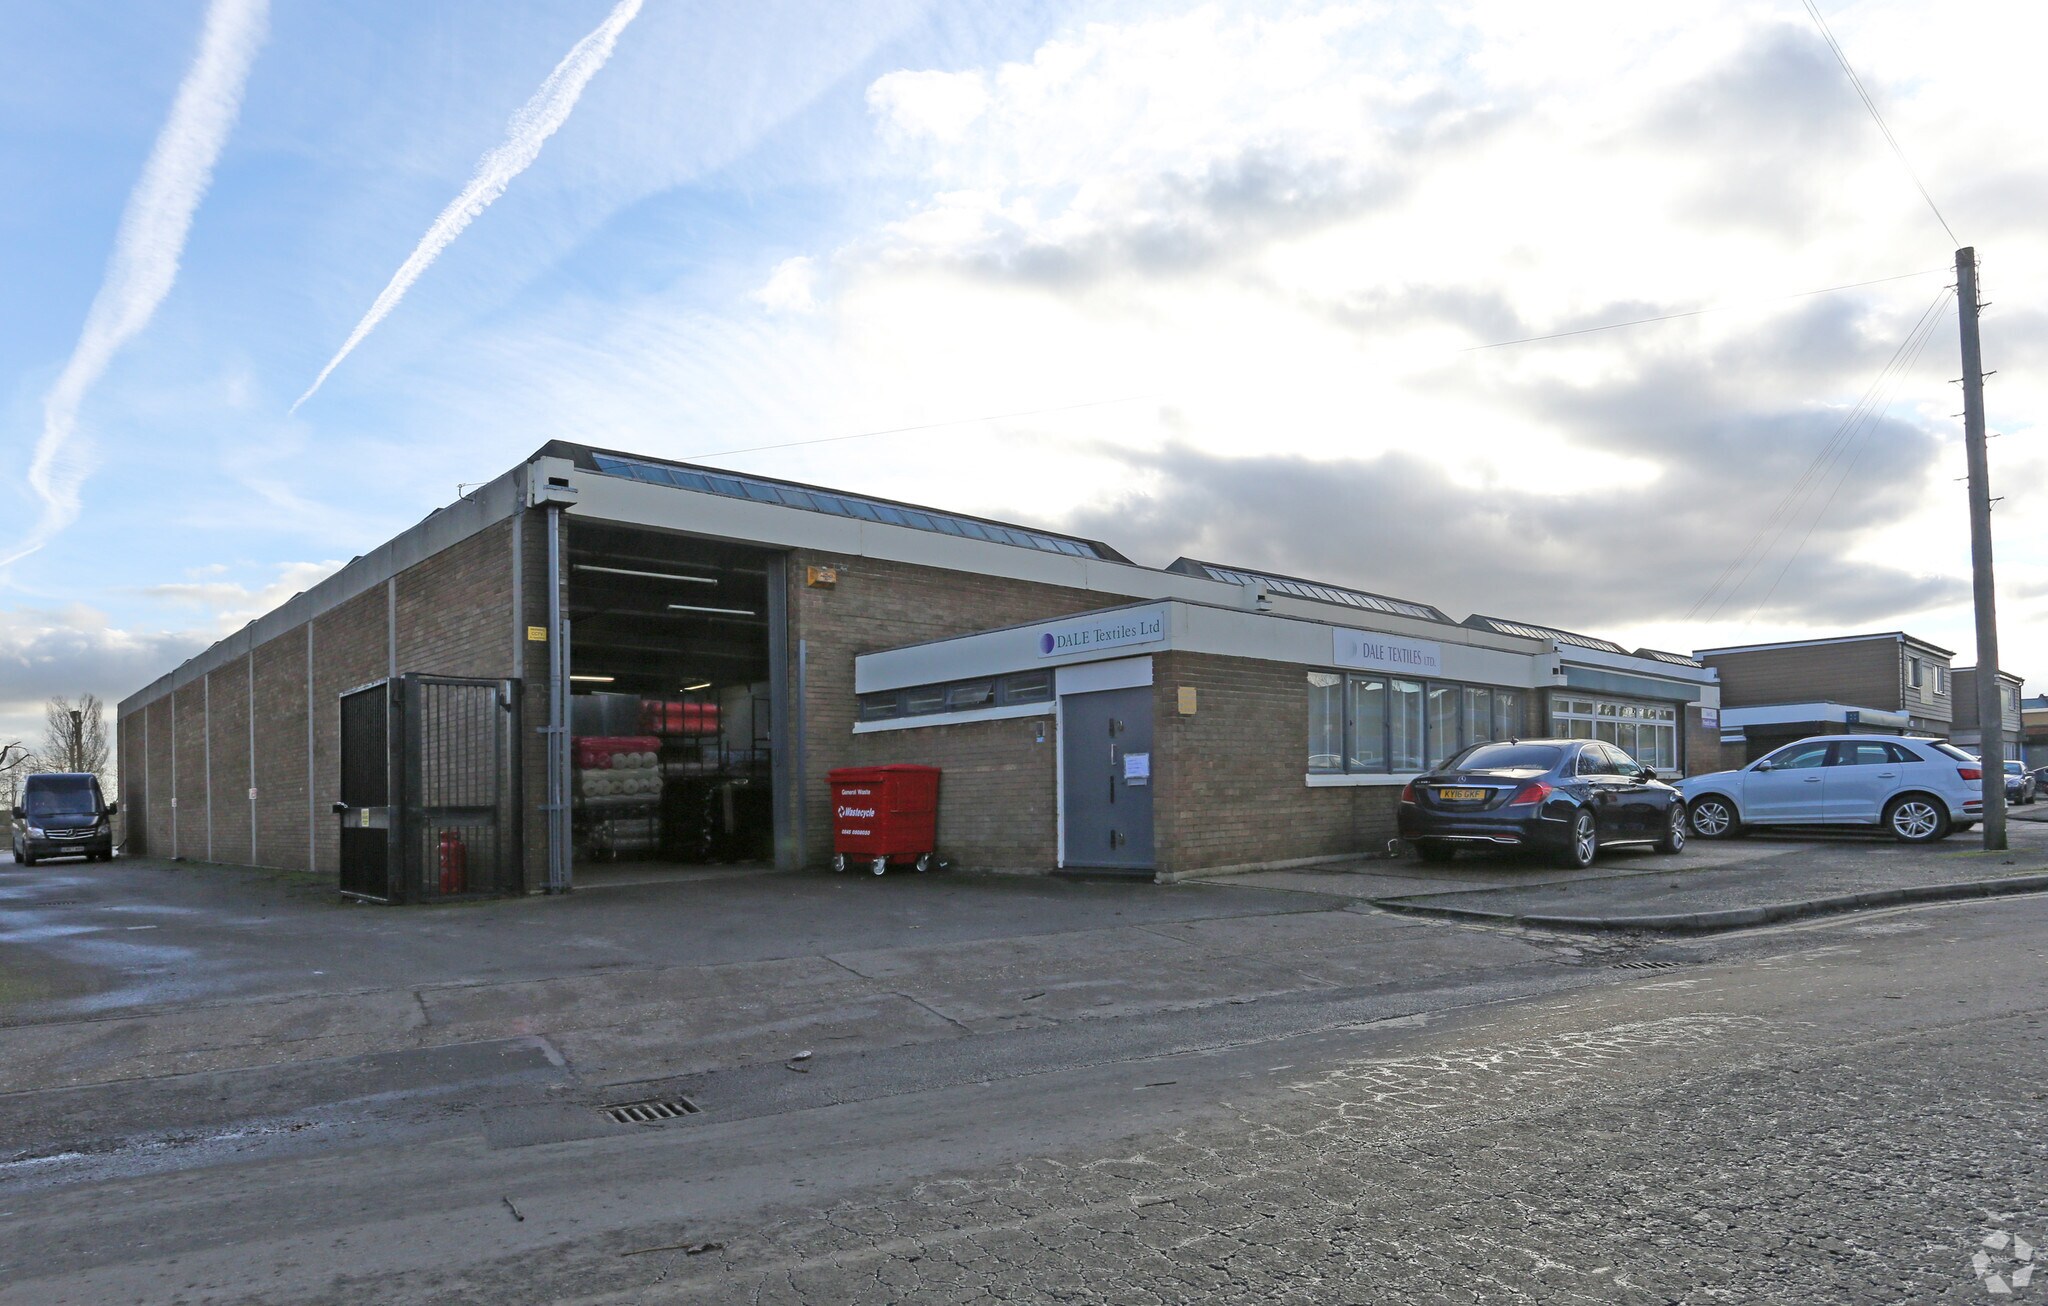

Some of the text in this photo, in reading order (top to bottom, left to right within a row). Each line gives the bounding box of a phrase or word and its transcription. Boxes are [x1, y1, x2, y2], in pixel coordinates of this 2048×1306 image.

[1057, 619, 1160, 648] DALE Textiles Ltd
[1363, 642, 1384, 660] DALE
[1388, 646, 1422, 665] TEXTILES
[845, 807, 875, 819] Wastecycle
